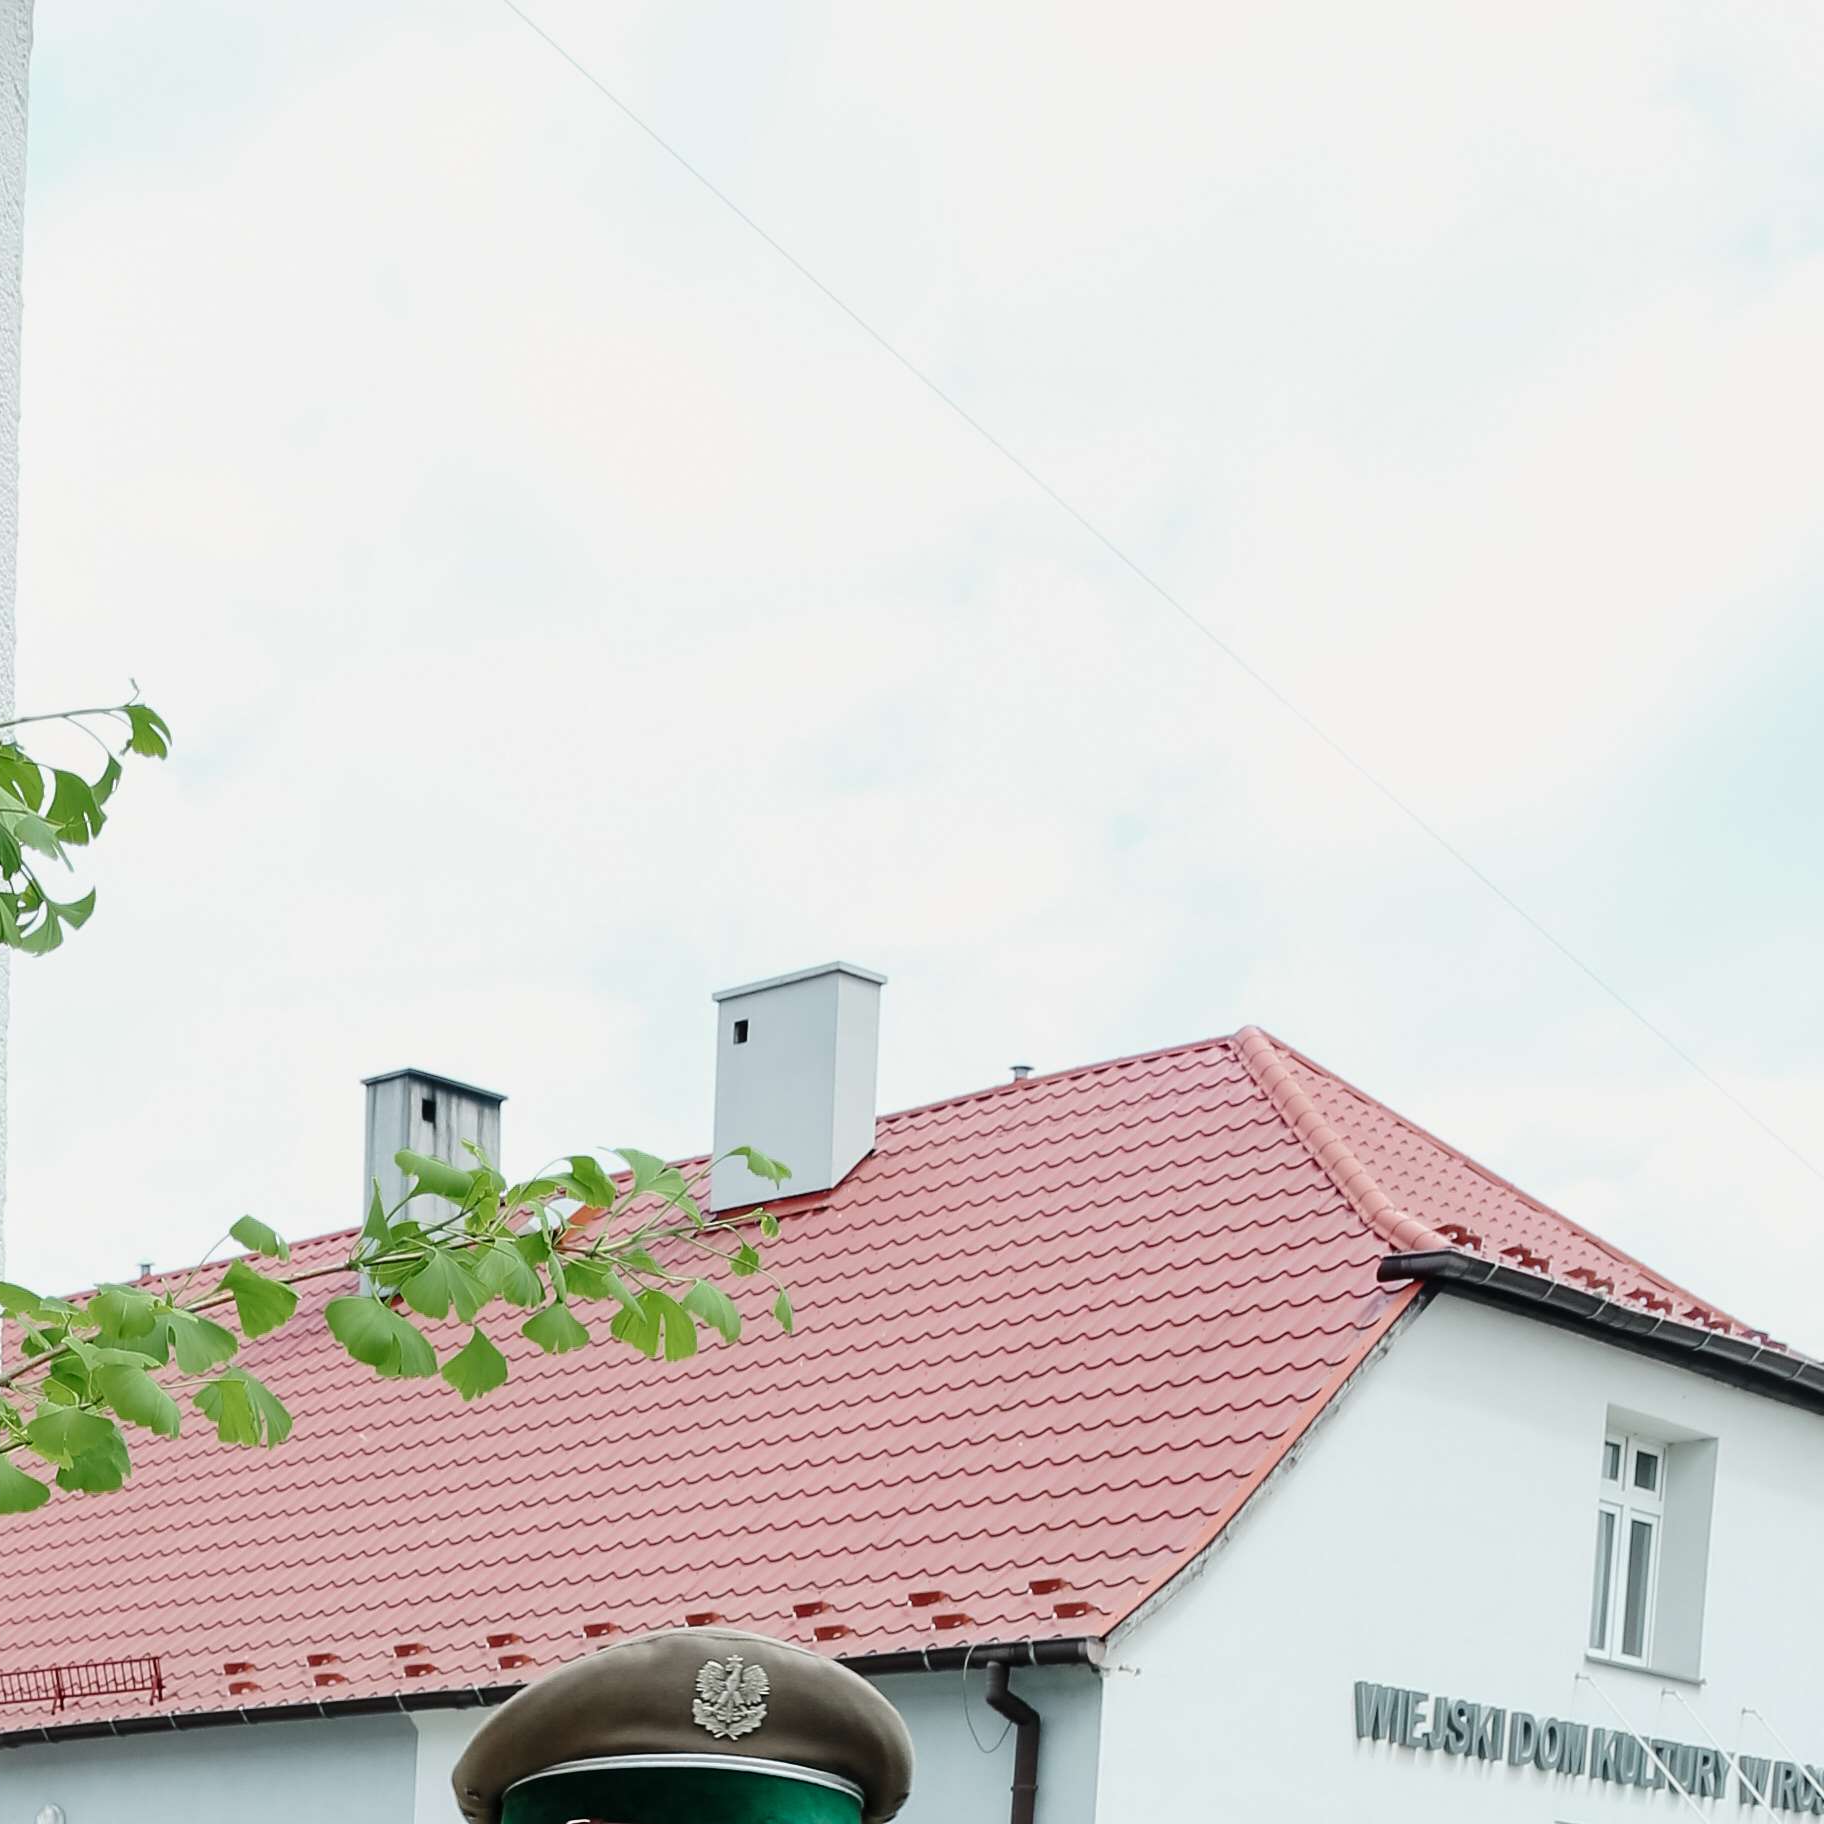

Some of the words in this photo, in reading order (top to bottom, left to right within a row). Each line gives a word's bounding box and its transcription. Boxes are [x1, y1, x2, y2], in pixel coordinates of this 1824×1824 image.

[1355, 1681, 1506, 1761] WIEJSKI
[1508, 1711, 1588, 1776] DOM
[1590, 1728, 1735, 1799] KULTURY
[1739, 1756, 1773, 1806] W
